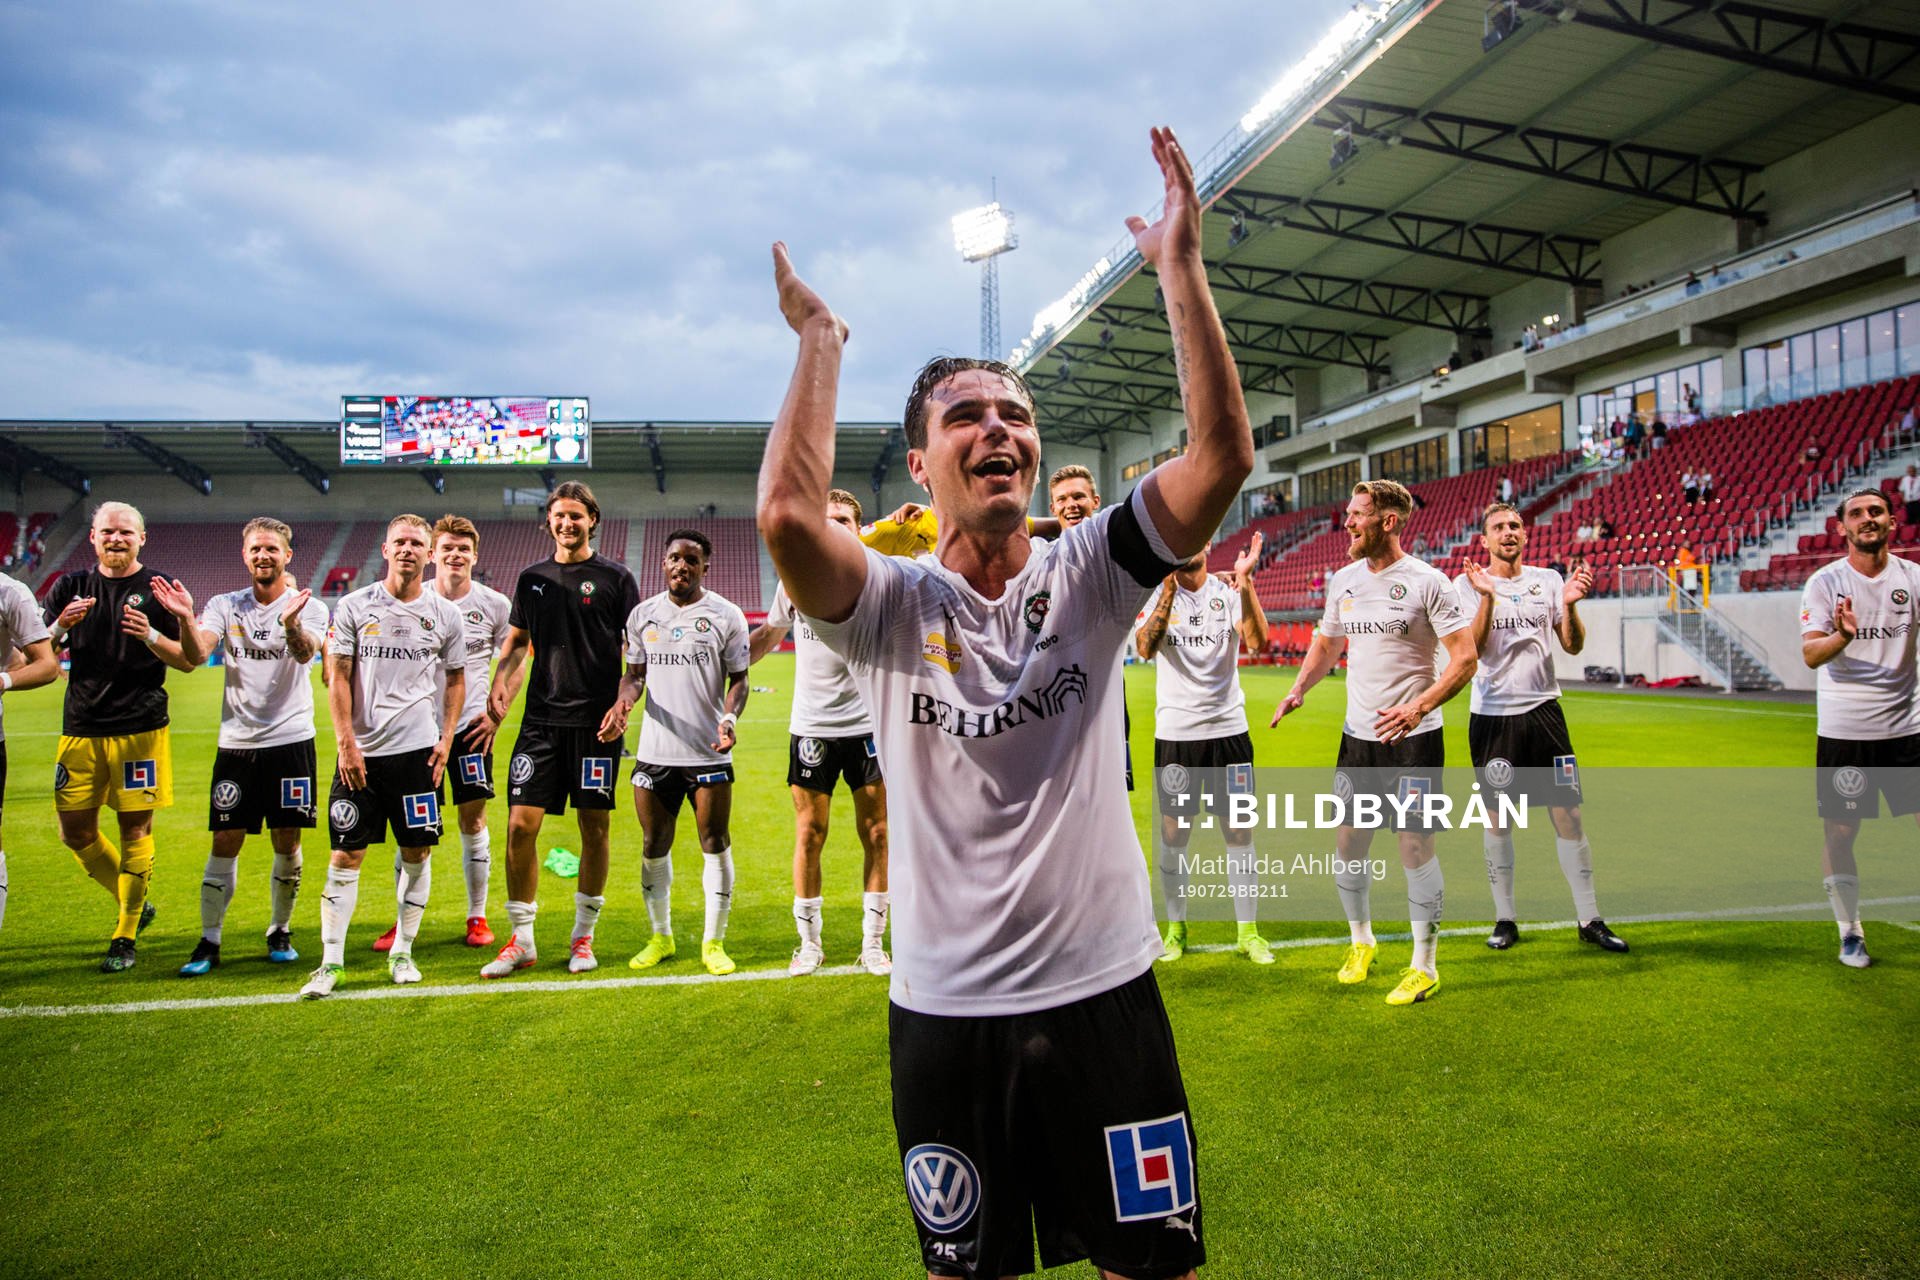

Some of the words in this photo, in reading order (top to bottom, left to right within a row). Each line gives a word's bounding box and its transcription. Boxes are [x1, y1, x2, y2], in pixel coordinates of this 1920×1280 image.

[360, 645, 413, 660] BEHRN
[908, 688, 1045, 738] BEHRN
[801, 768, 811, 778] 10
[219, 814, 230, 822] 15
[339, 835, 345, 843] 7
